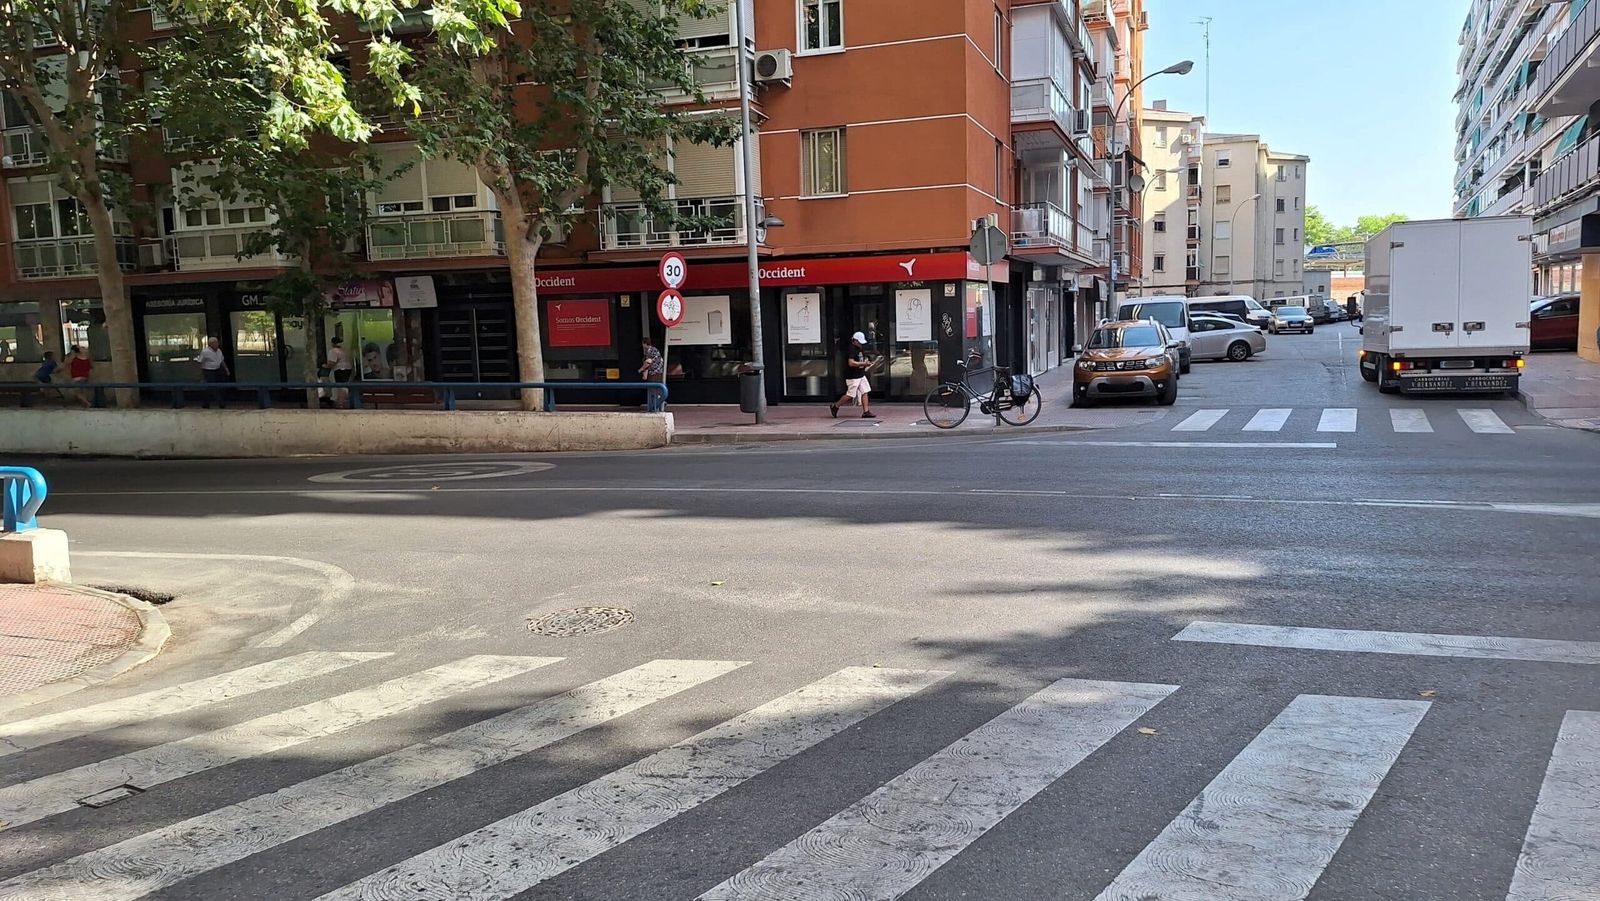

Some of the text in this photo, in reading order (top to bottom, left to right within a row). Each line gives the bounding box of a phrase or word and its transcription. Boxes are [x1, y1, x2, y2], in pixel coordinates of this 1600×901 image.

[666, 265, 681, 277] 30
[758, 267, 805, 279] Occident
[535, 277, 576, 287] Occident
